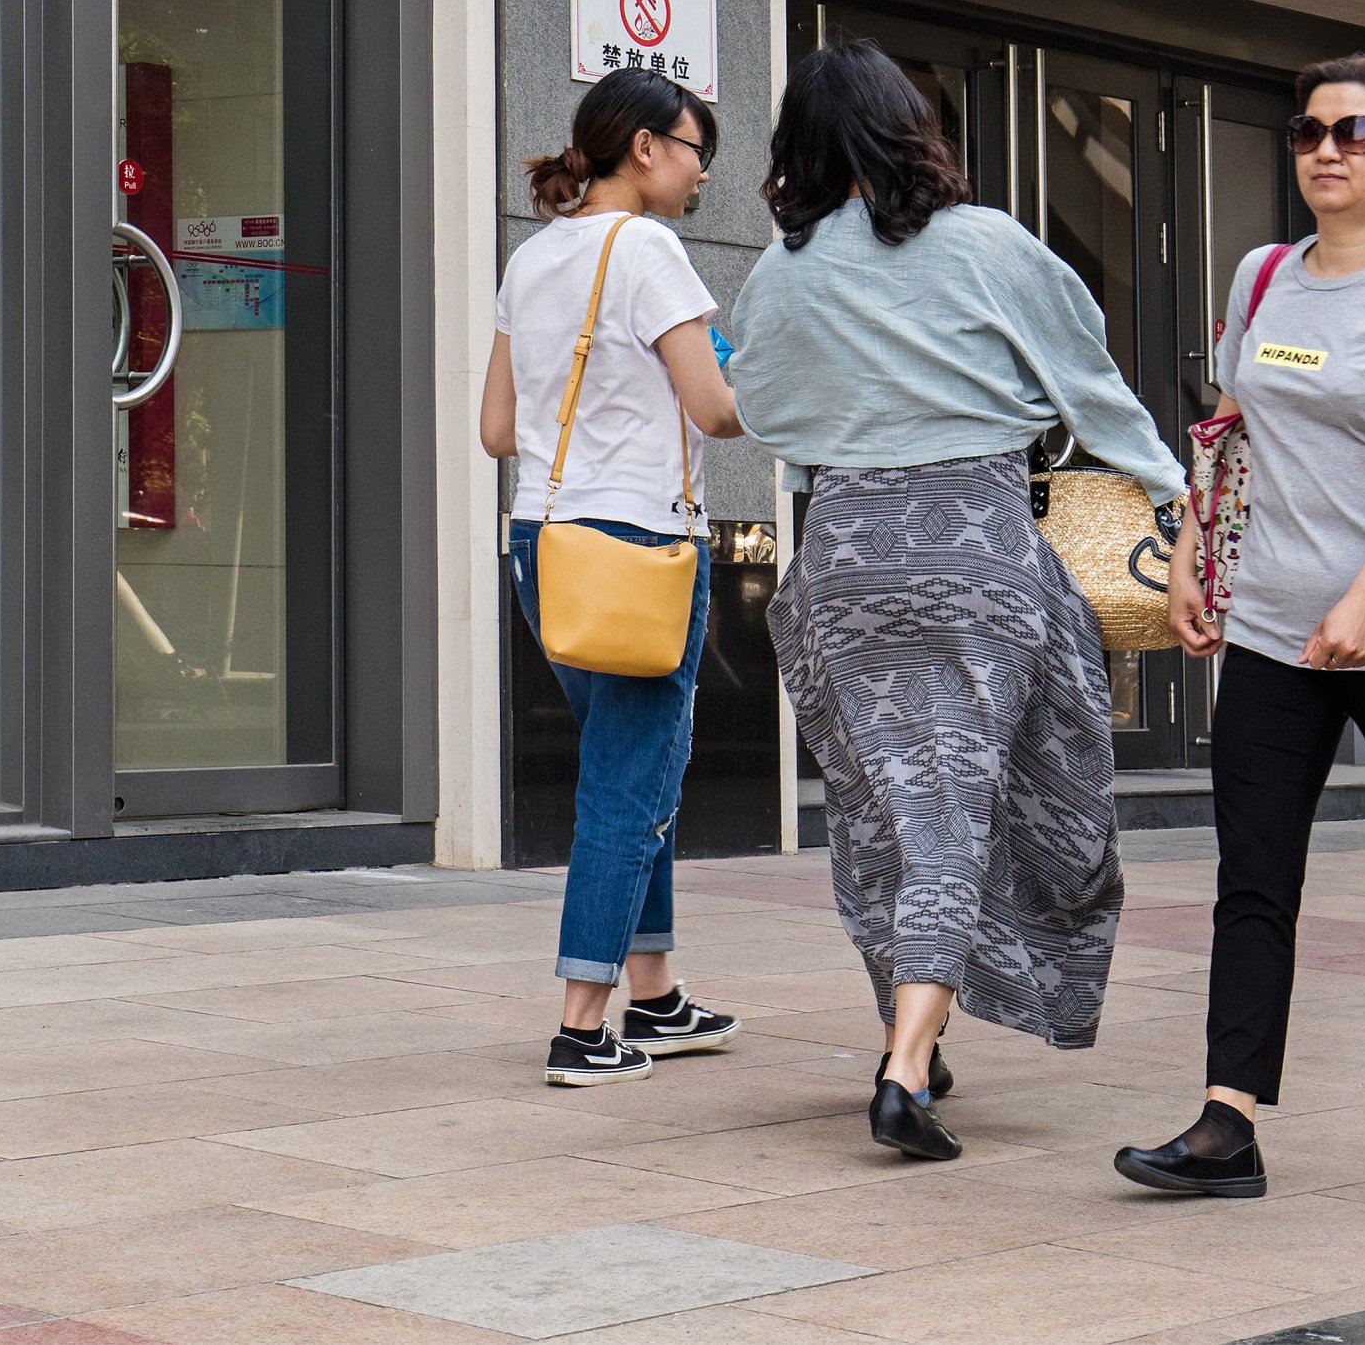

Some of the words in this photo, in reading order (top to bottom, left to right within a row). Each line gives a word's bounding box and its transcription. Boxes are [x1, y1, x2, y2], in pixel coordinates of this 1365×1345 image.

[602, 43, 690, 80] 禁放单位
[124, 164, 135, 178] 拉
[1261, 348, 1319, 365] HIPANDA
